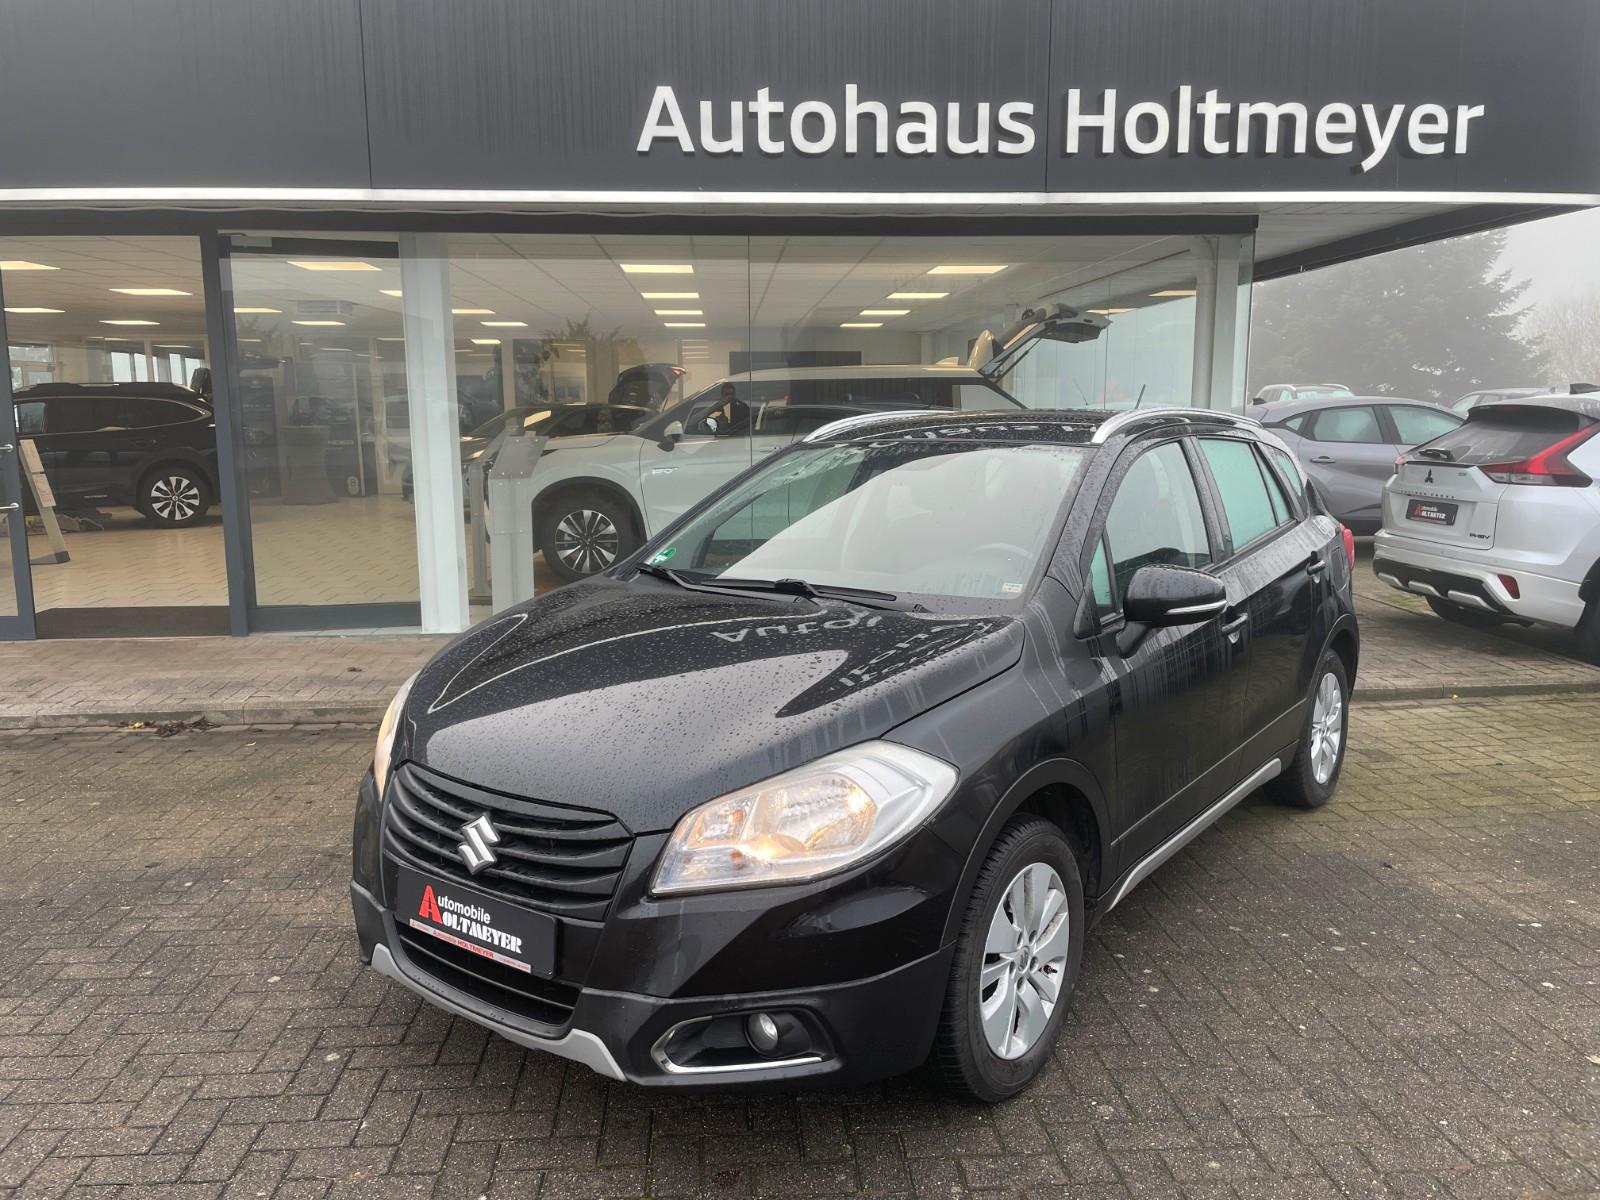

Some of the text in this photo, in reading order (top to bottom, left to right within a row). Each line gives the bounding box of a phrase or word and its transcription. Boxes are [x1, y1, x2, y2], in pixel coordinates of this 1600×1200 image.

[636, 83, 1485, 173] Autohaus Holtmeyer
[418, 884, 492, 924] Automobile
